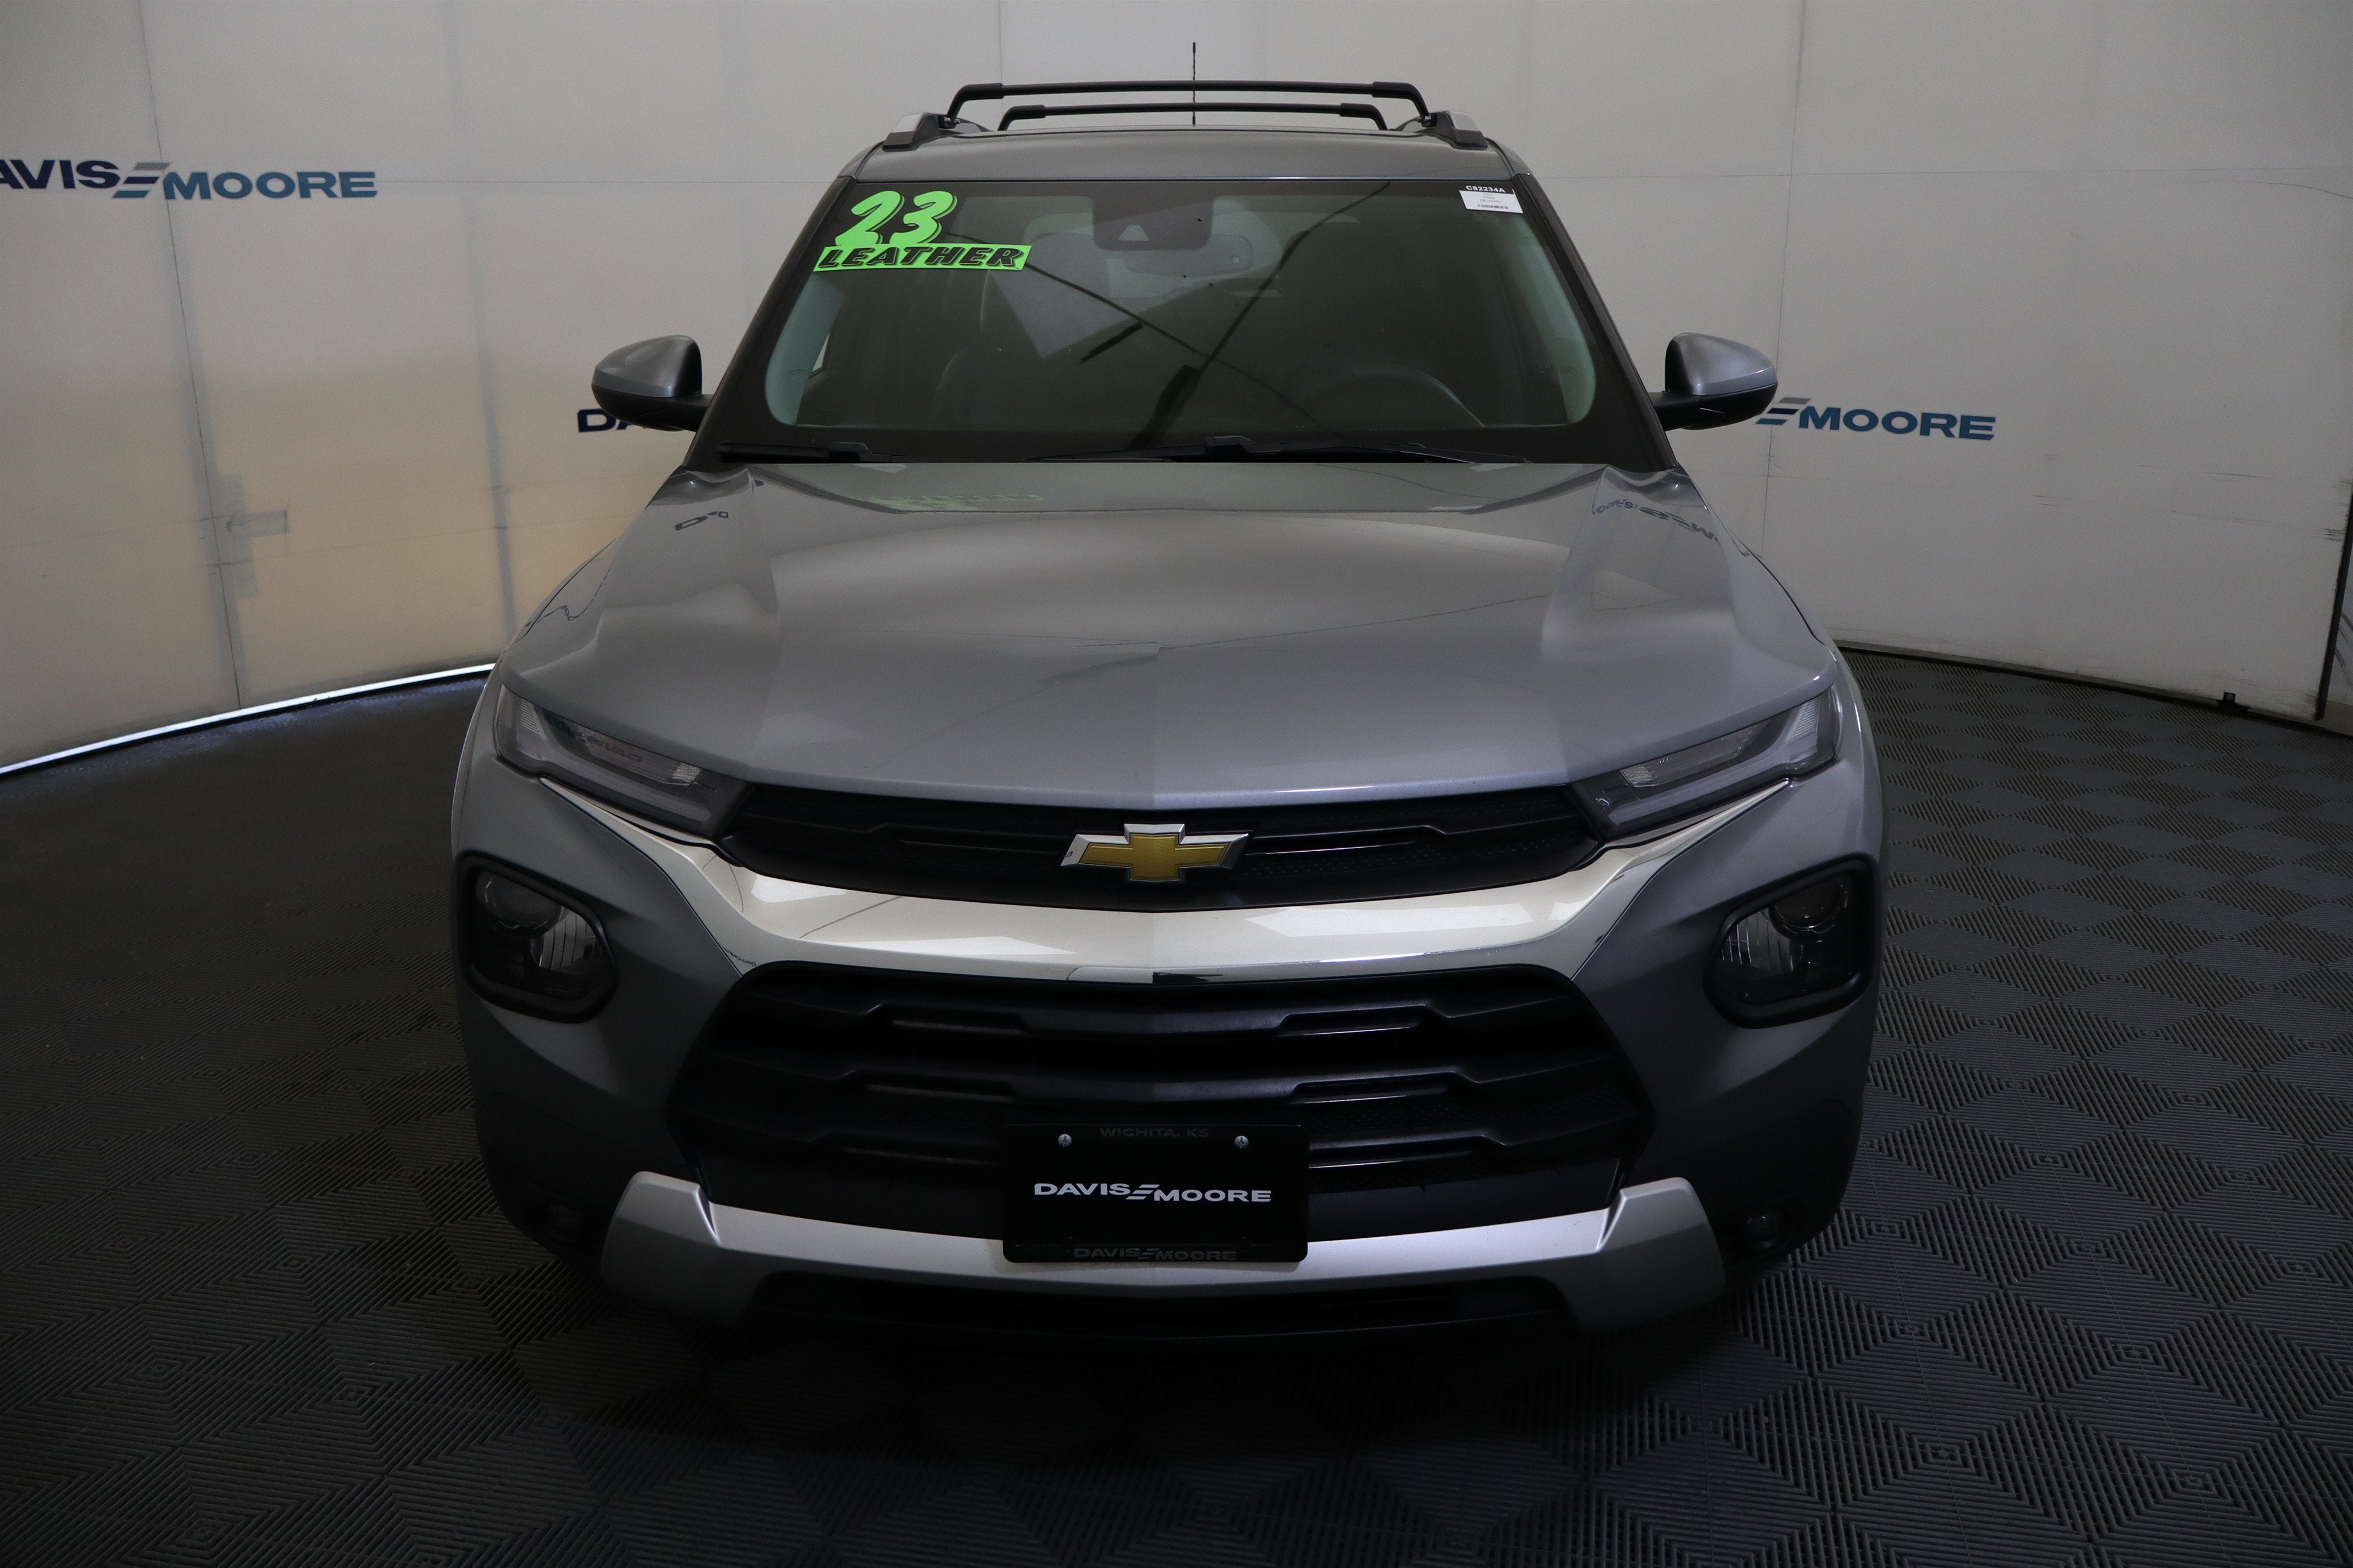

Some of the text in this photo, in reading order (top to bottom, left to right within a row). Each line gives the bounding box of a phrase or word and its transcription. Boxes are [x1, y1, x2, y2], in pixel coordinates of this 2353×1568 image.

[164, 172, 377, 199] MOORE
[835, 190, 957, 246] 23
[818, 247, 1024, 269] LEATHER
[1799, 406, 1996, 440] MOORE
[1186, 1129, 1209, 1137] KS
[1034, 1183, 1271, 1202] DAVIS MOORE
[1074, 1248, 1237, 1260] DAVIS MOORE
